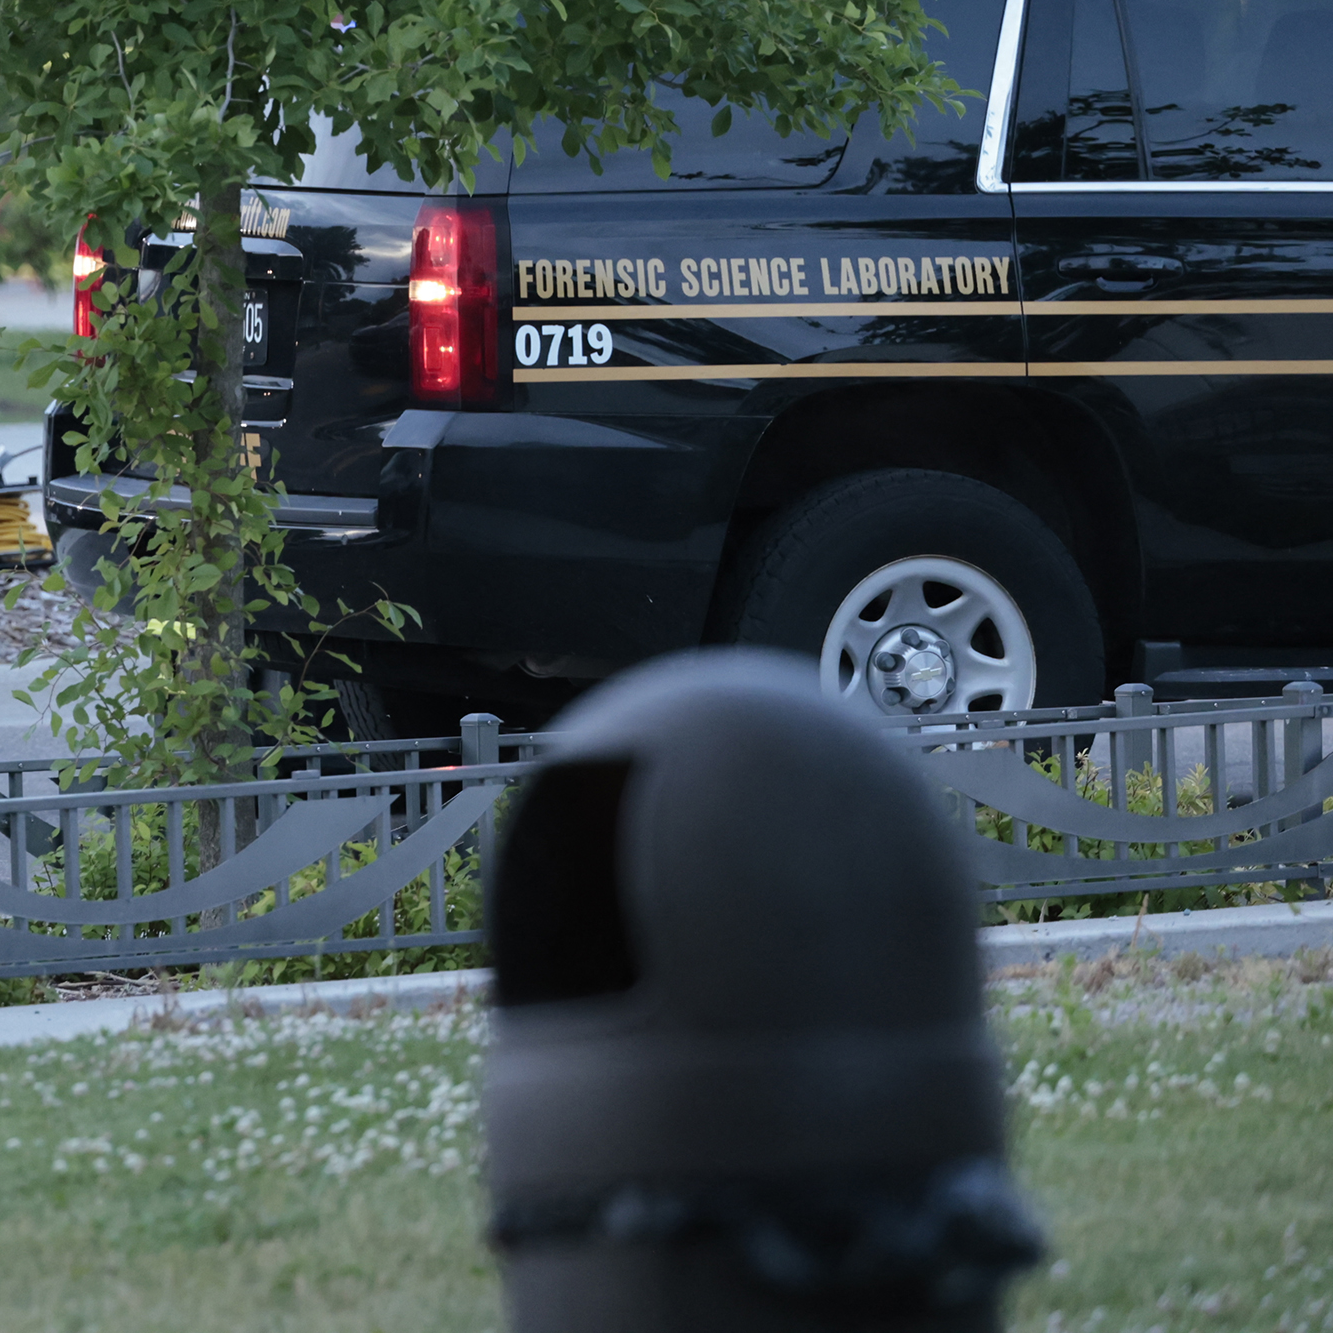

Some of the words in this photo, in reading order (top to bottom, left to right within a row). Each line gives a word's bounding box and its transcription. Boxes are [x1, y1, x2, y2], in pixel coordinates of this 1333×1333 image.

[518, 257, 667, 299] FORENSIC
[680, 256, 809, 298] SCIENCE
[823, 255, 1012, 297] LABORATORY
[243, 302, 264, 344] 05
[514, 322, 614, 367] 0719
